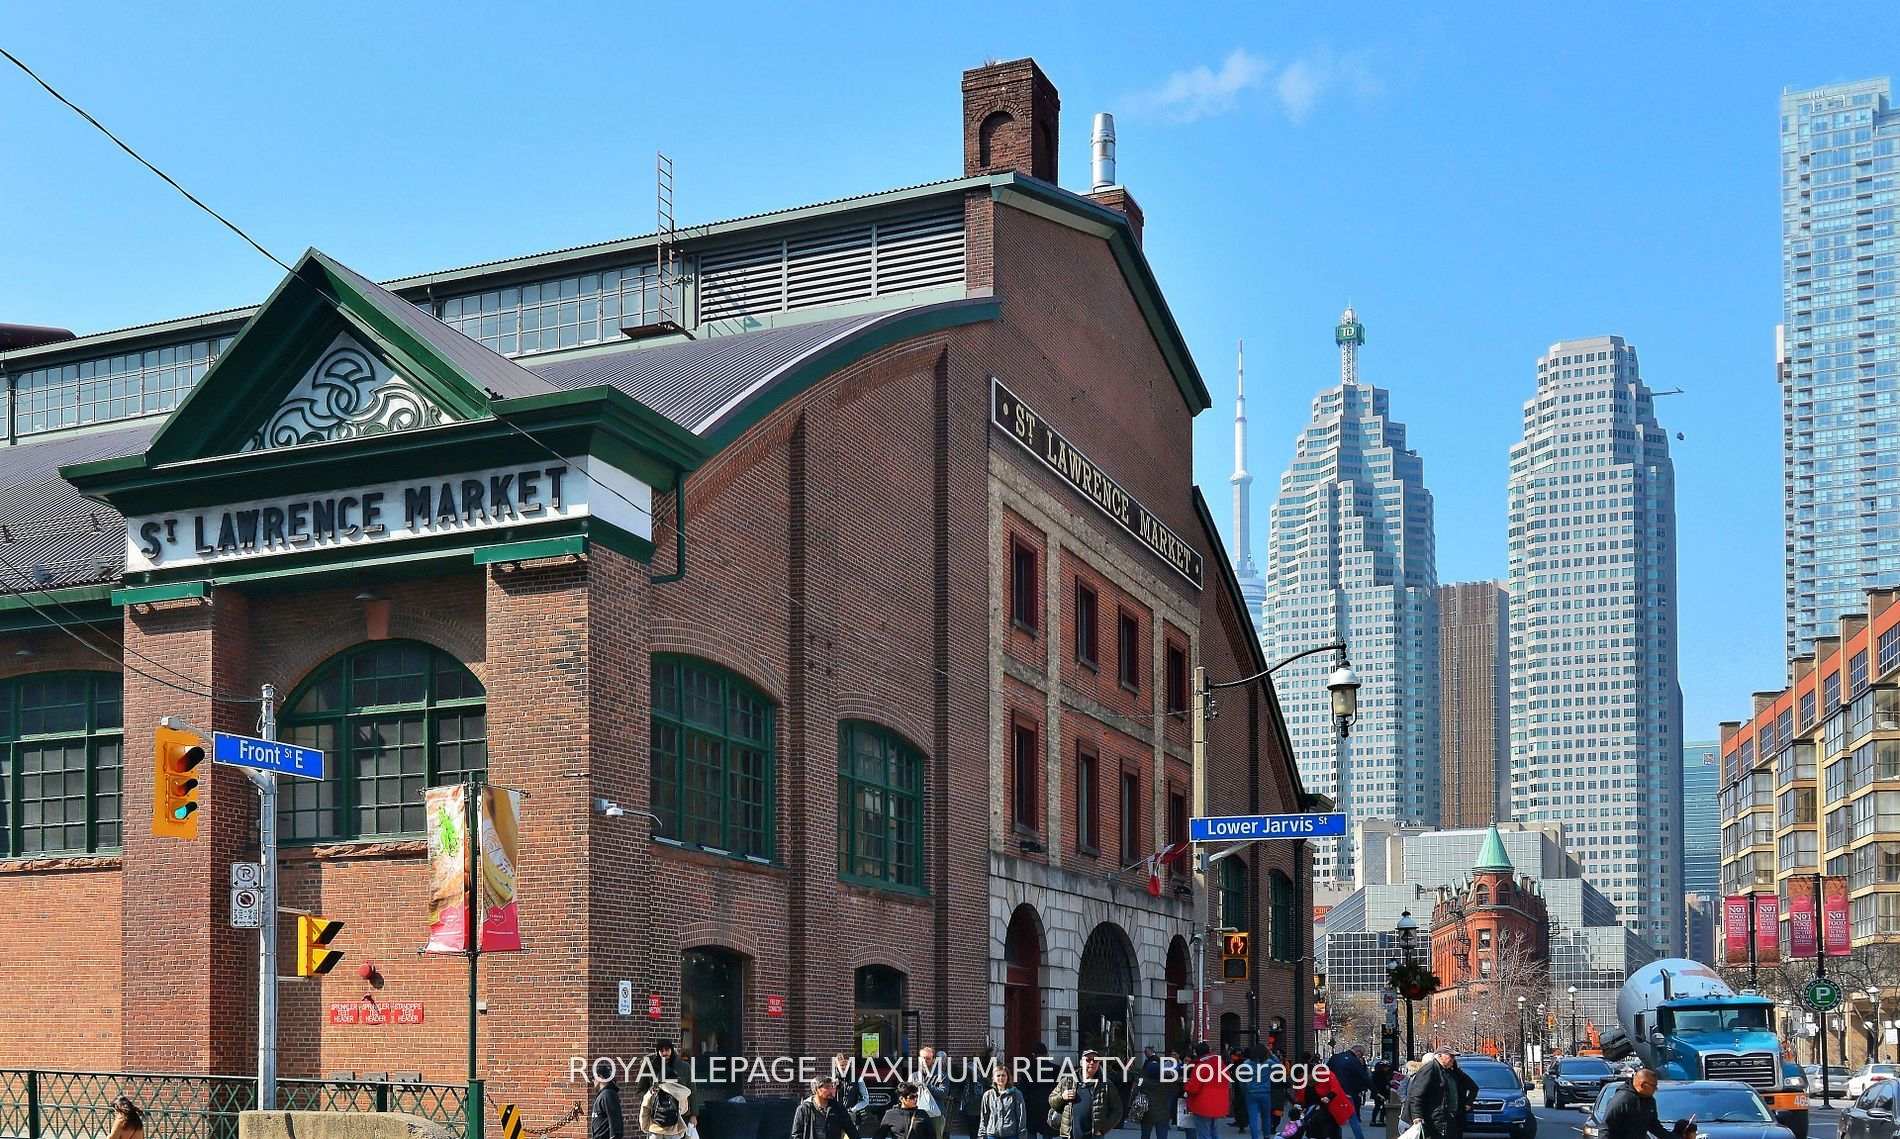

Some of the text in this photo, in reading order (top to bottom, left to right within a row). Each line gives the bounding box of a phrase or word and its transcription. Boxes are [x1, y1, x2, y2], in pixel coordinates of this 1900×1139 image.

[1341, 327, 1354, 336] TD
[195, 492, 385, 555] LAWRENCE
[404, 466, 568, 528] MARKET
[1047, 430, 1129, 525] LAWRENCE
[1139, 509, 1191, 575] MARKET
[240, 740, 304, 769] Front St E
[1207, 816, 1328, 835] Lower Jarvis St
[1815, 986, 1831, 1001] P
